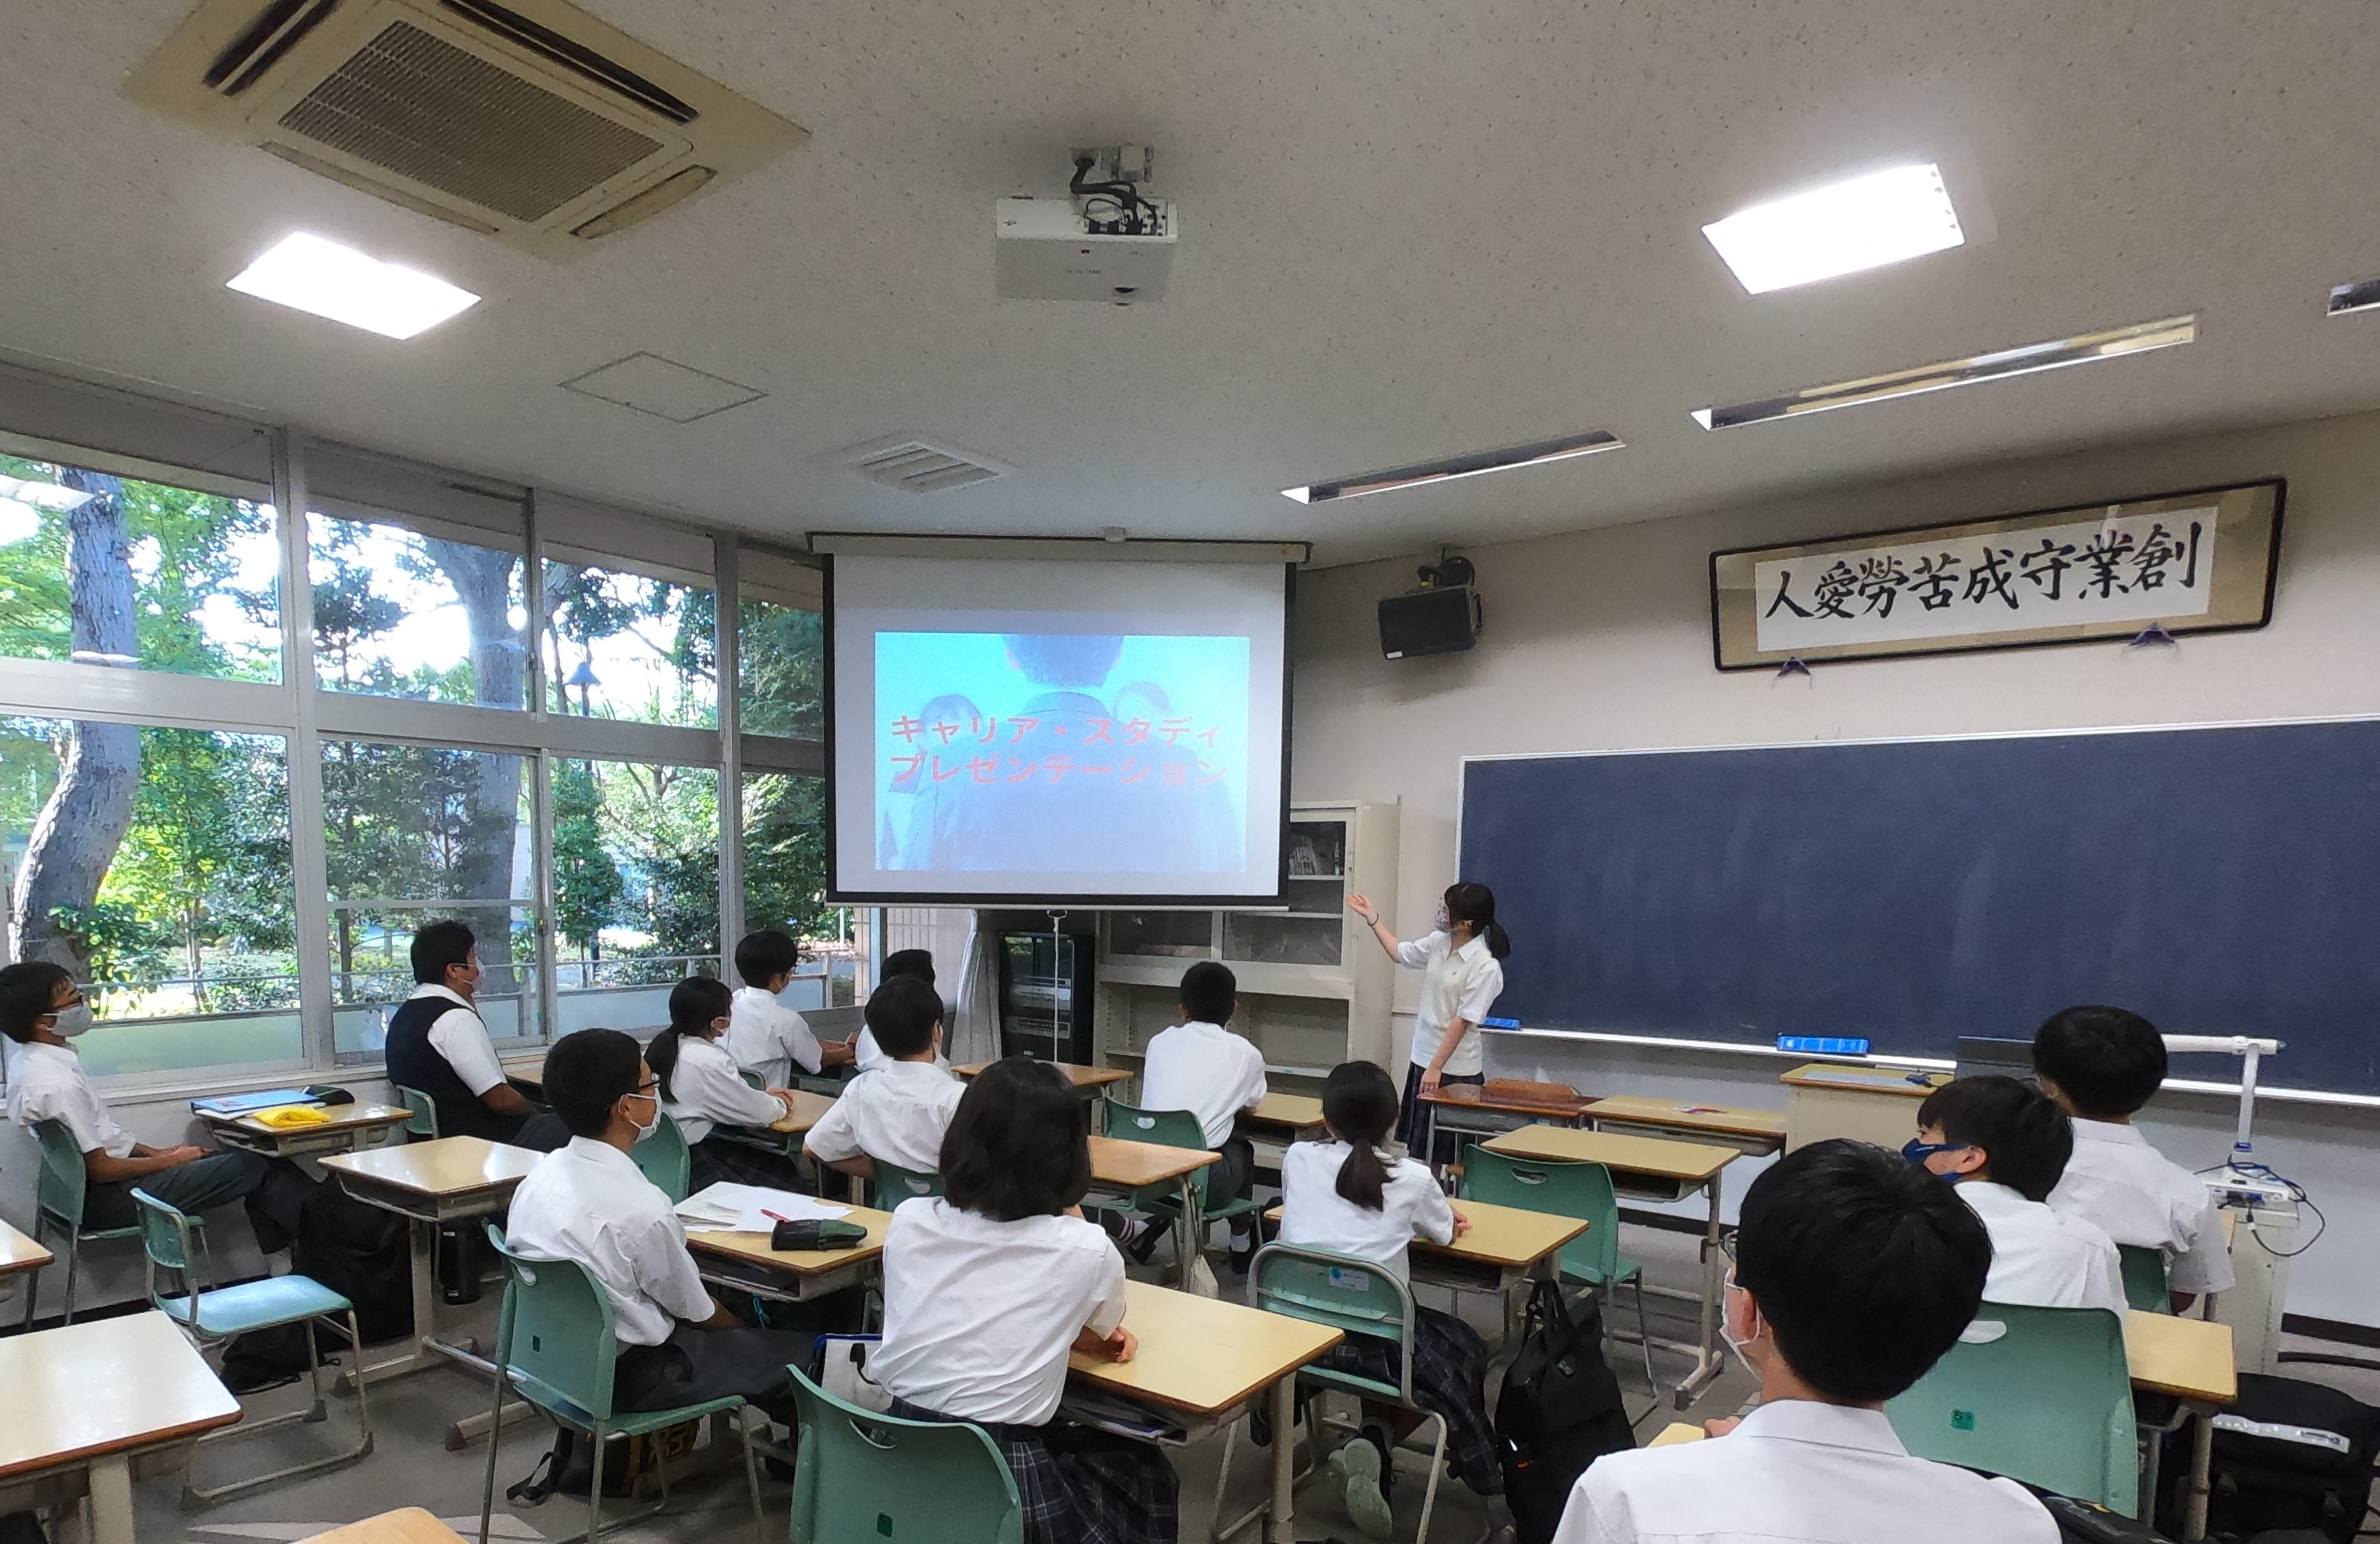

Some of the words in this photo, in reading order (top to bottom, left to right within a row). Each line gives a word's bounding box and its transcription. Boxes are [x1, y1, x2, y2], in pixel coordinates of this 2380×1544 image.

[890, 714, 1223, 749] キャリア・スタディ
[889, 752, 1228, 786] プレゼンテーション
